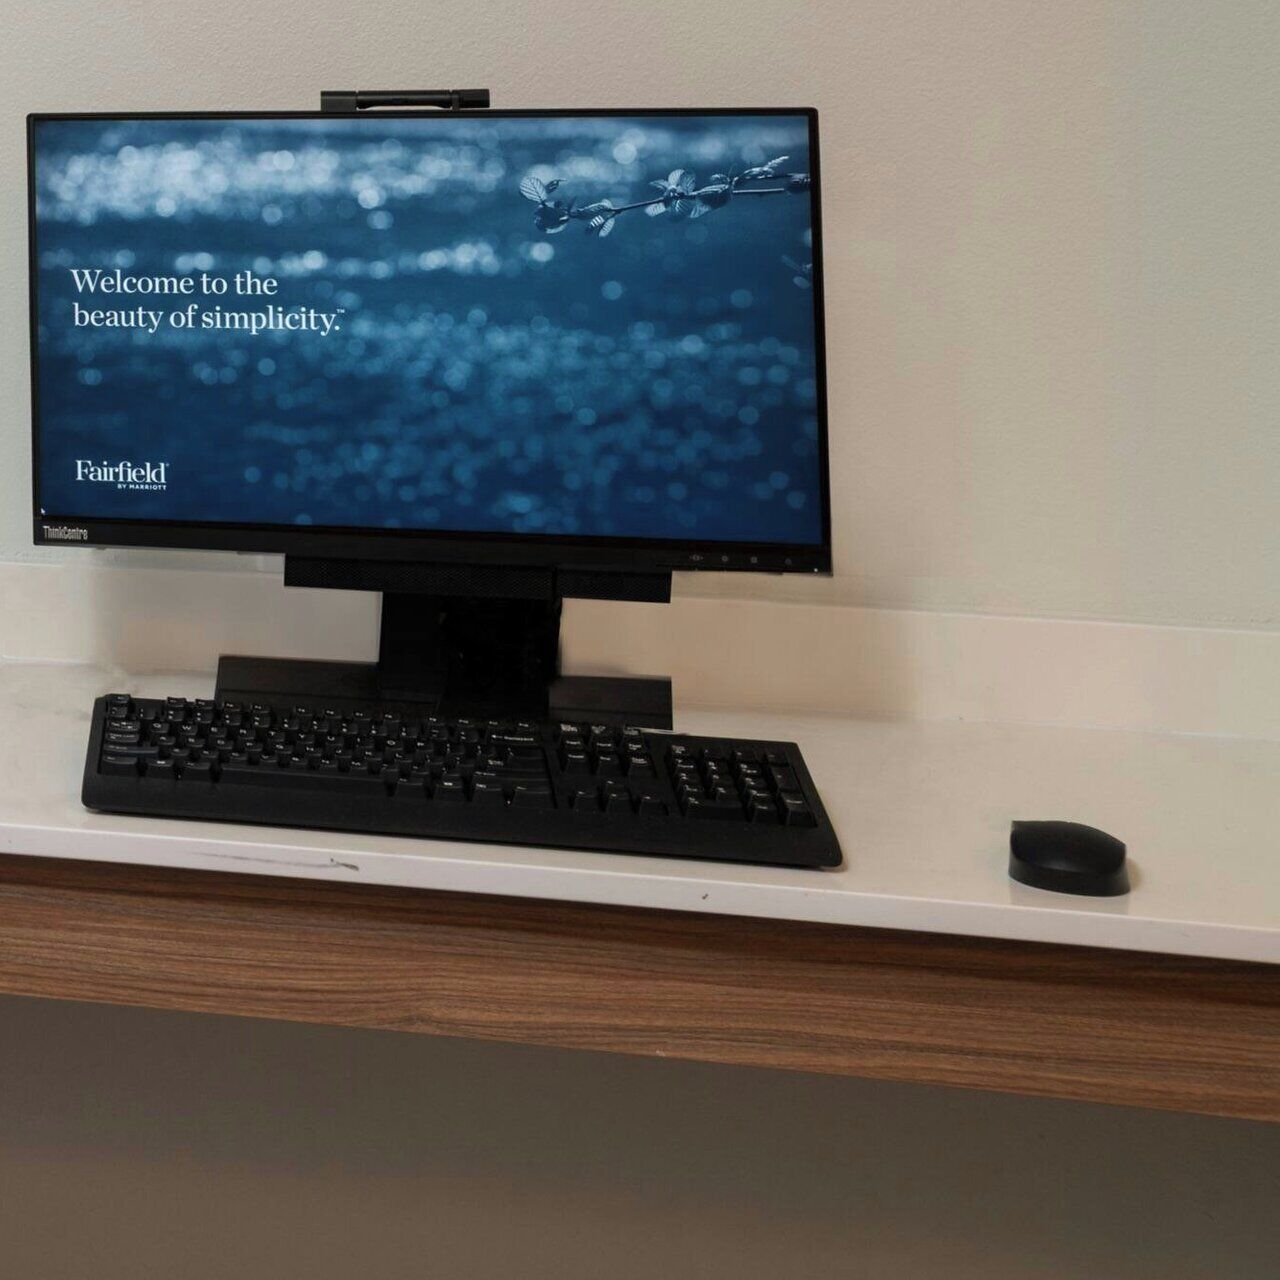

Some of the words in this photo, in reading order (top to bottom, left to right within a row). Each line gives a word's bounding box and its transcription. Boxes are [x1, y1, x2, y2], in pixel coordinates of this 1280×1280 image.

[70, 269, 194, 295] Welcome
[201, 272, 228, 295] to
[234, 271, 278, 296] the
[72, 302, 164, 334] beauty
[169, 303, 198, 329] of
[129, 483, 167, 491] MARRIOTT
